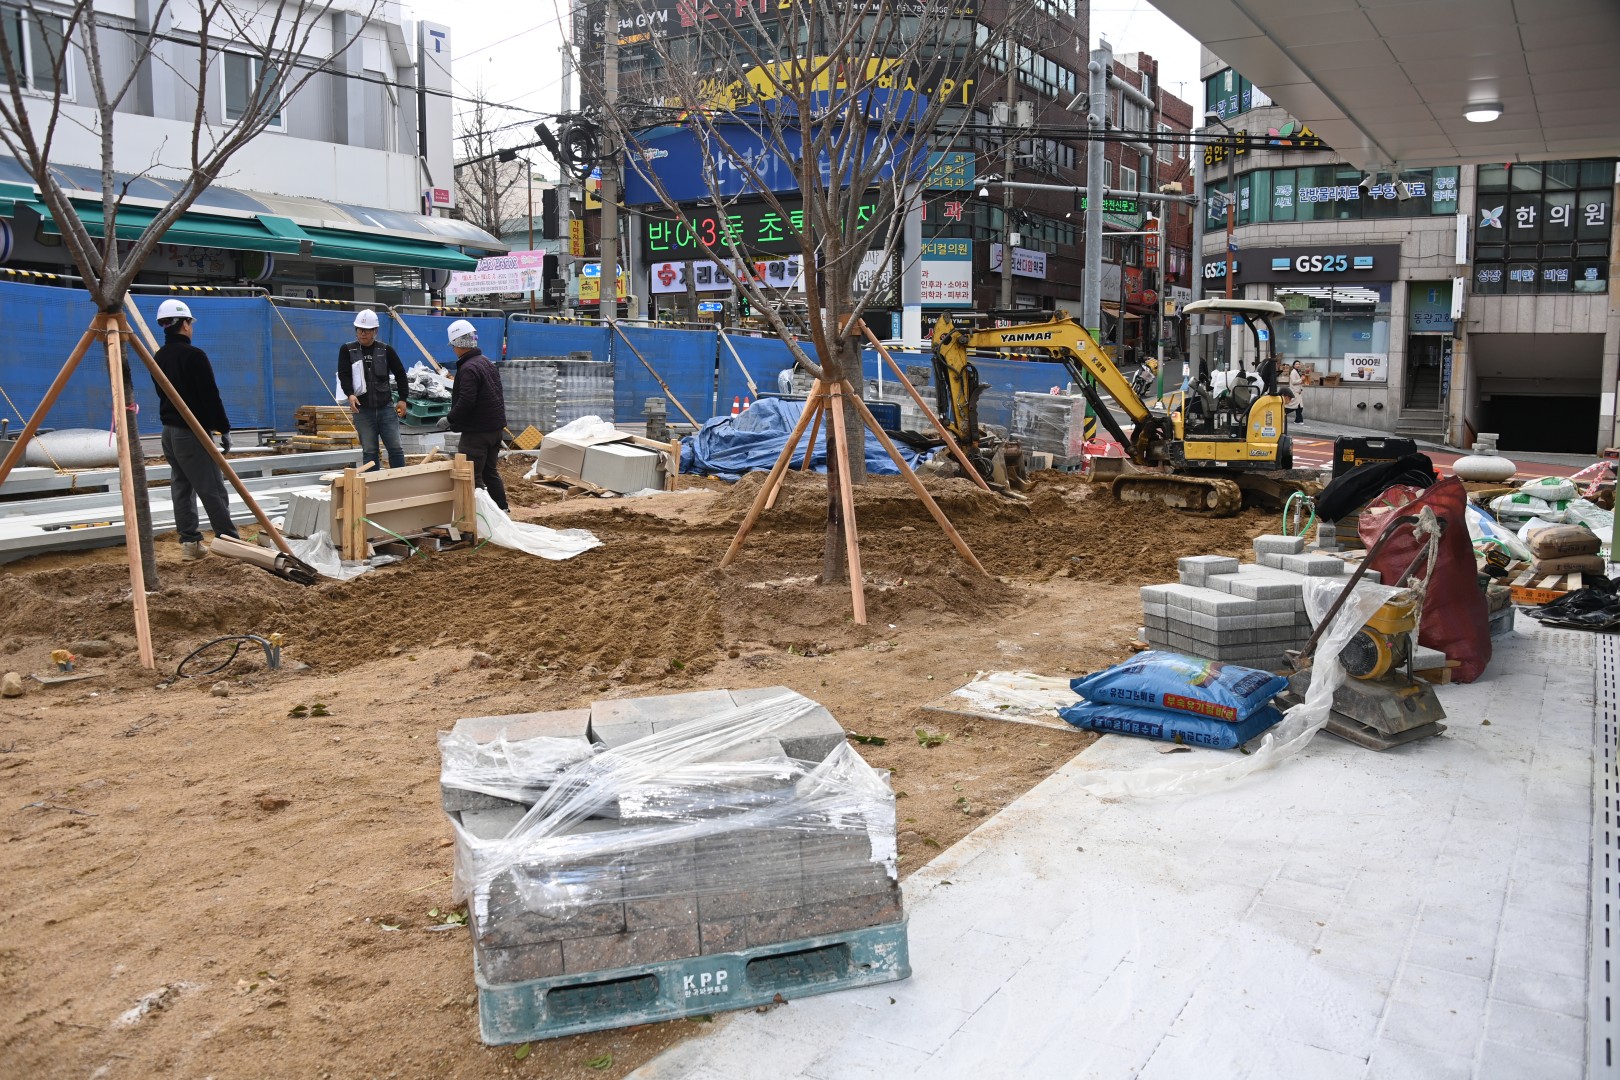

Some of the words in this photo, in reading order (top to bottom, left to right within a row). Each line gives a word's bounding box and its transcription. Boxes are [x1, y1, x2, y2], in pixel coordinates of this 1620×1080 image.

[1299, 186, 1360, 202] 한방물리치료
[649, 214, 745, 251] 반여3동
[1205, 260, 1226, 279] GS25
[1296, 255, 1348, 273] GS25
[1478, 269, 1502, 282] 성장
[1510, 269, 1535, 282] 비만
[1544, 268, 1568, 282] 비염
[1413, 312, 1453, 325] 동광교회
[1000, 331, 1052, 343] YANMAR
[1350, 357, 1381, 367] 1000원
[683, 969, 729, 990] KPP
